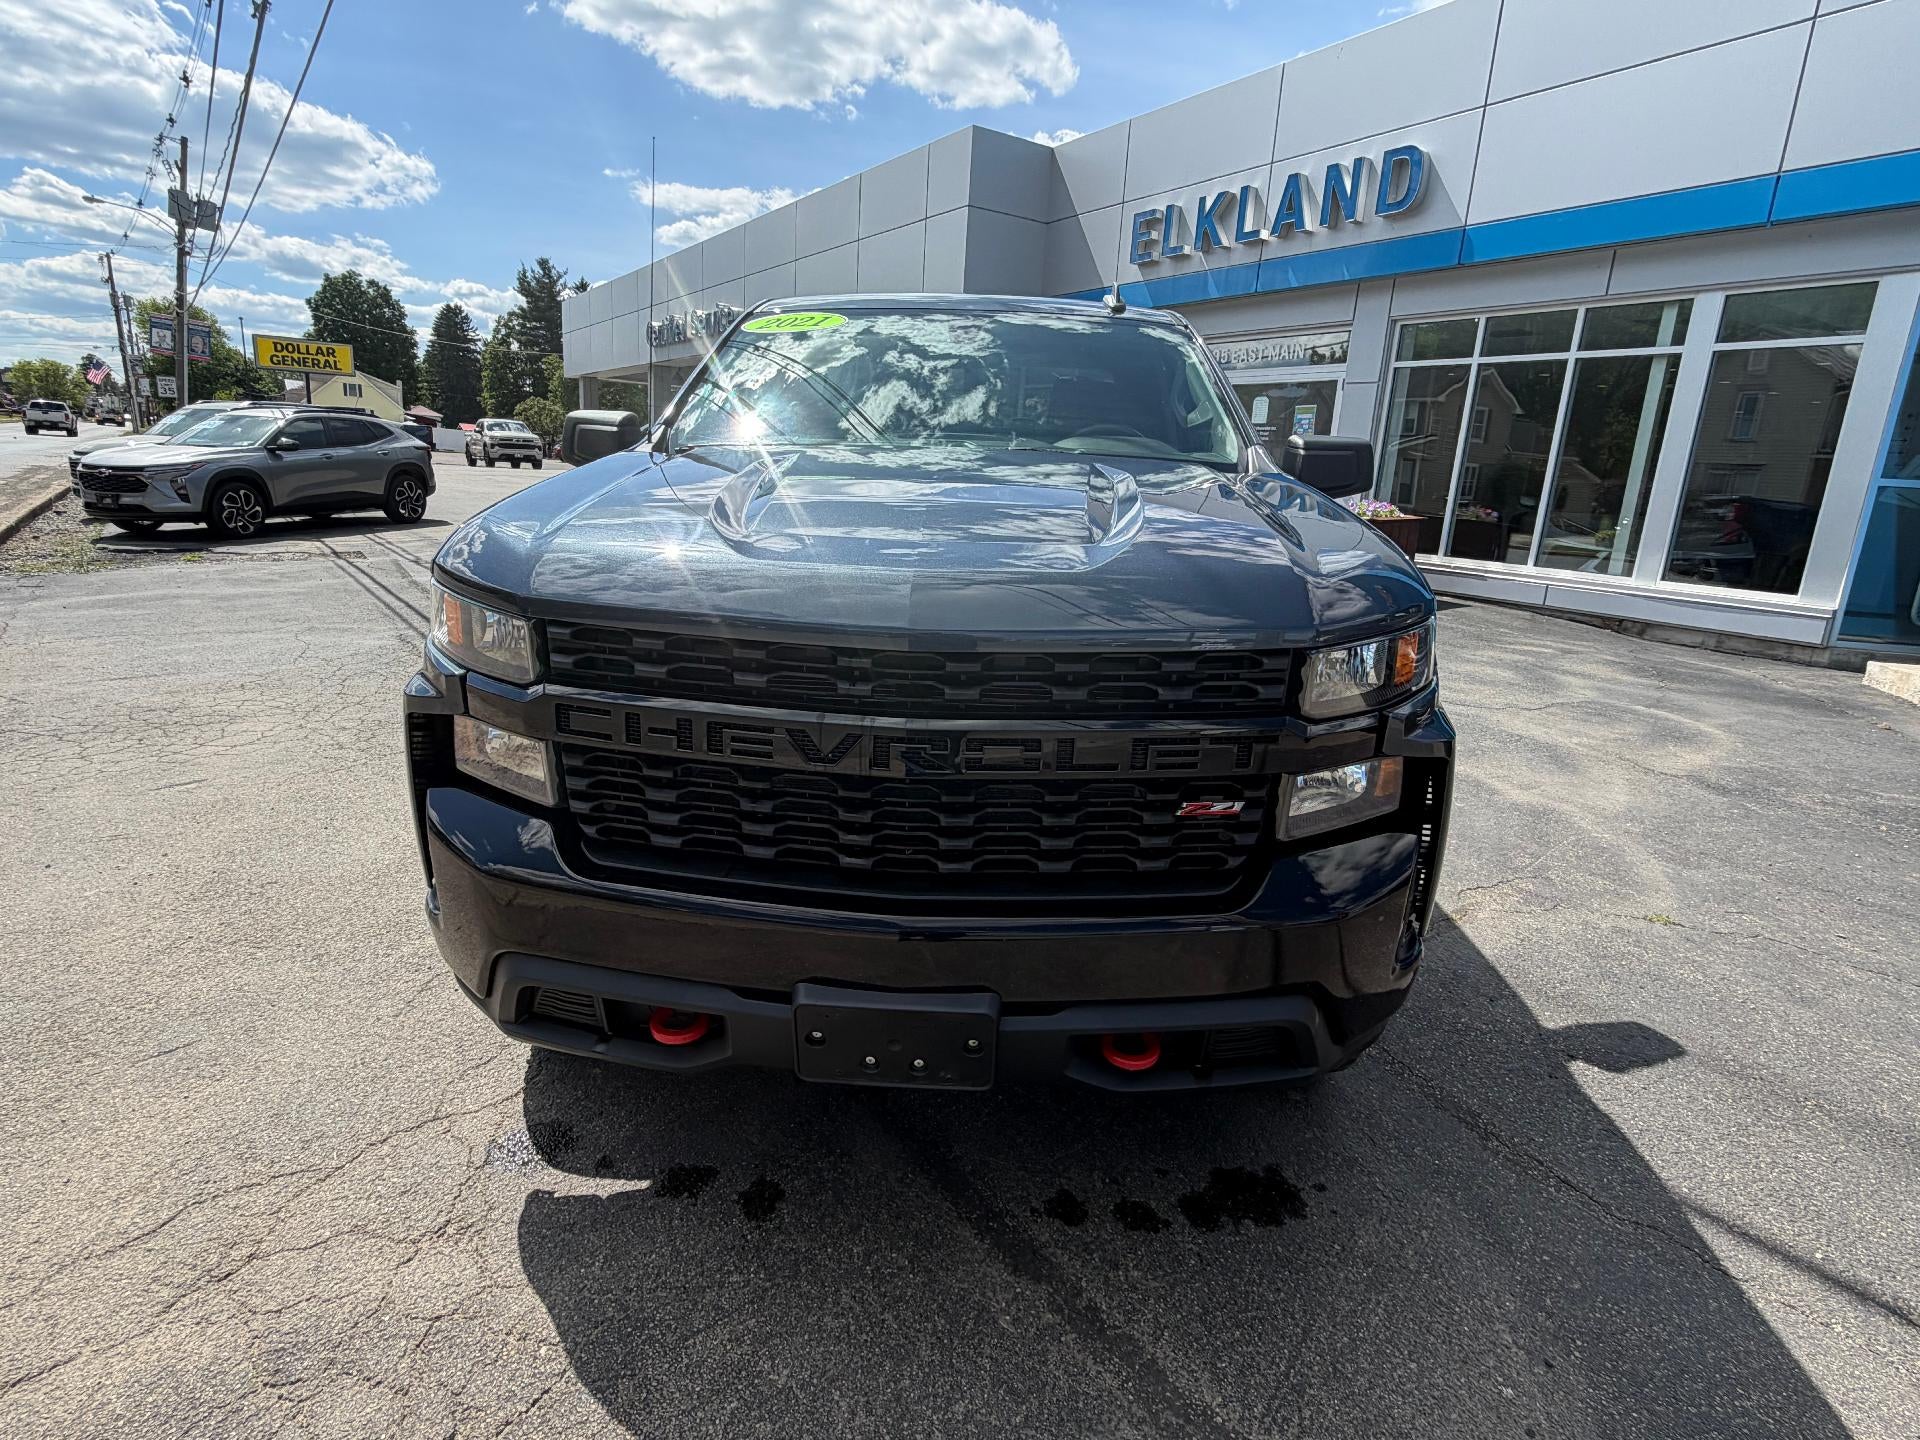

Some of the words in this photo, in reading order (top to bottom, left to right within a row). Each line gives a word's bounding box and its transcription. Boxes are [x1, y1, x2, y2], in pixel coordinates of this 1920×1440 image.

[1130, 145, 1428, 264] ELKLAND
[756, 316, 833, 329] 2021
[272, 341, 337, 358] DOLLAR
[1231, 345, 1267, 363] EAST
[1268, 343, 1306, 361] MAIN
[269, 354, 342, 371] GENERAL
[160, 387, 175, 395] 35
[555, 702, 1282, 774] CHEVROLET
